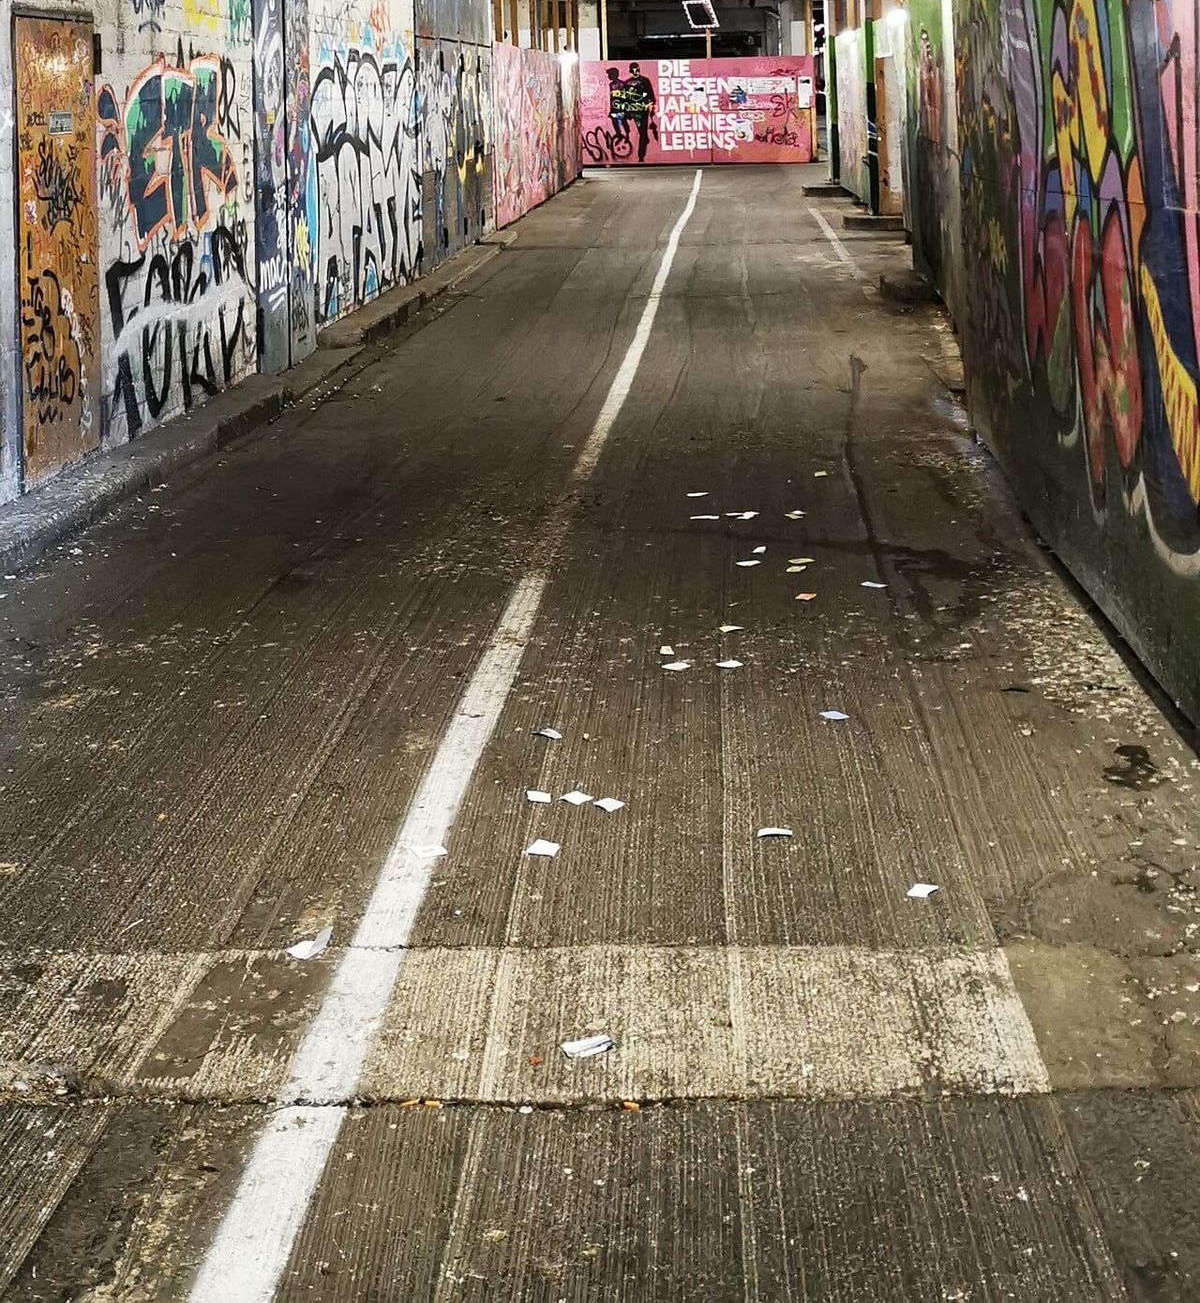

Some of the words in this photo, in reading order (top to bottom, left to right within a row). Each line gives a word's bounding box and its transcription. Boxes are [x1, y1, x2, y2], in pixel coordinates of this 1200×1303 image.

[657, 60, 691, 77] DIE
[658, 77, 730, 95] BESTEN
[657, 95, 720, 116] JAHRE
[660, 113, 739, 131] MEINES
